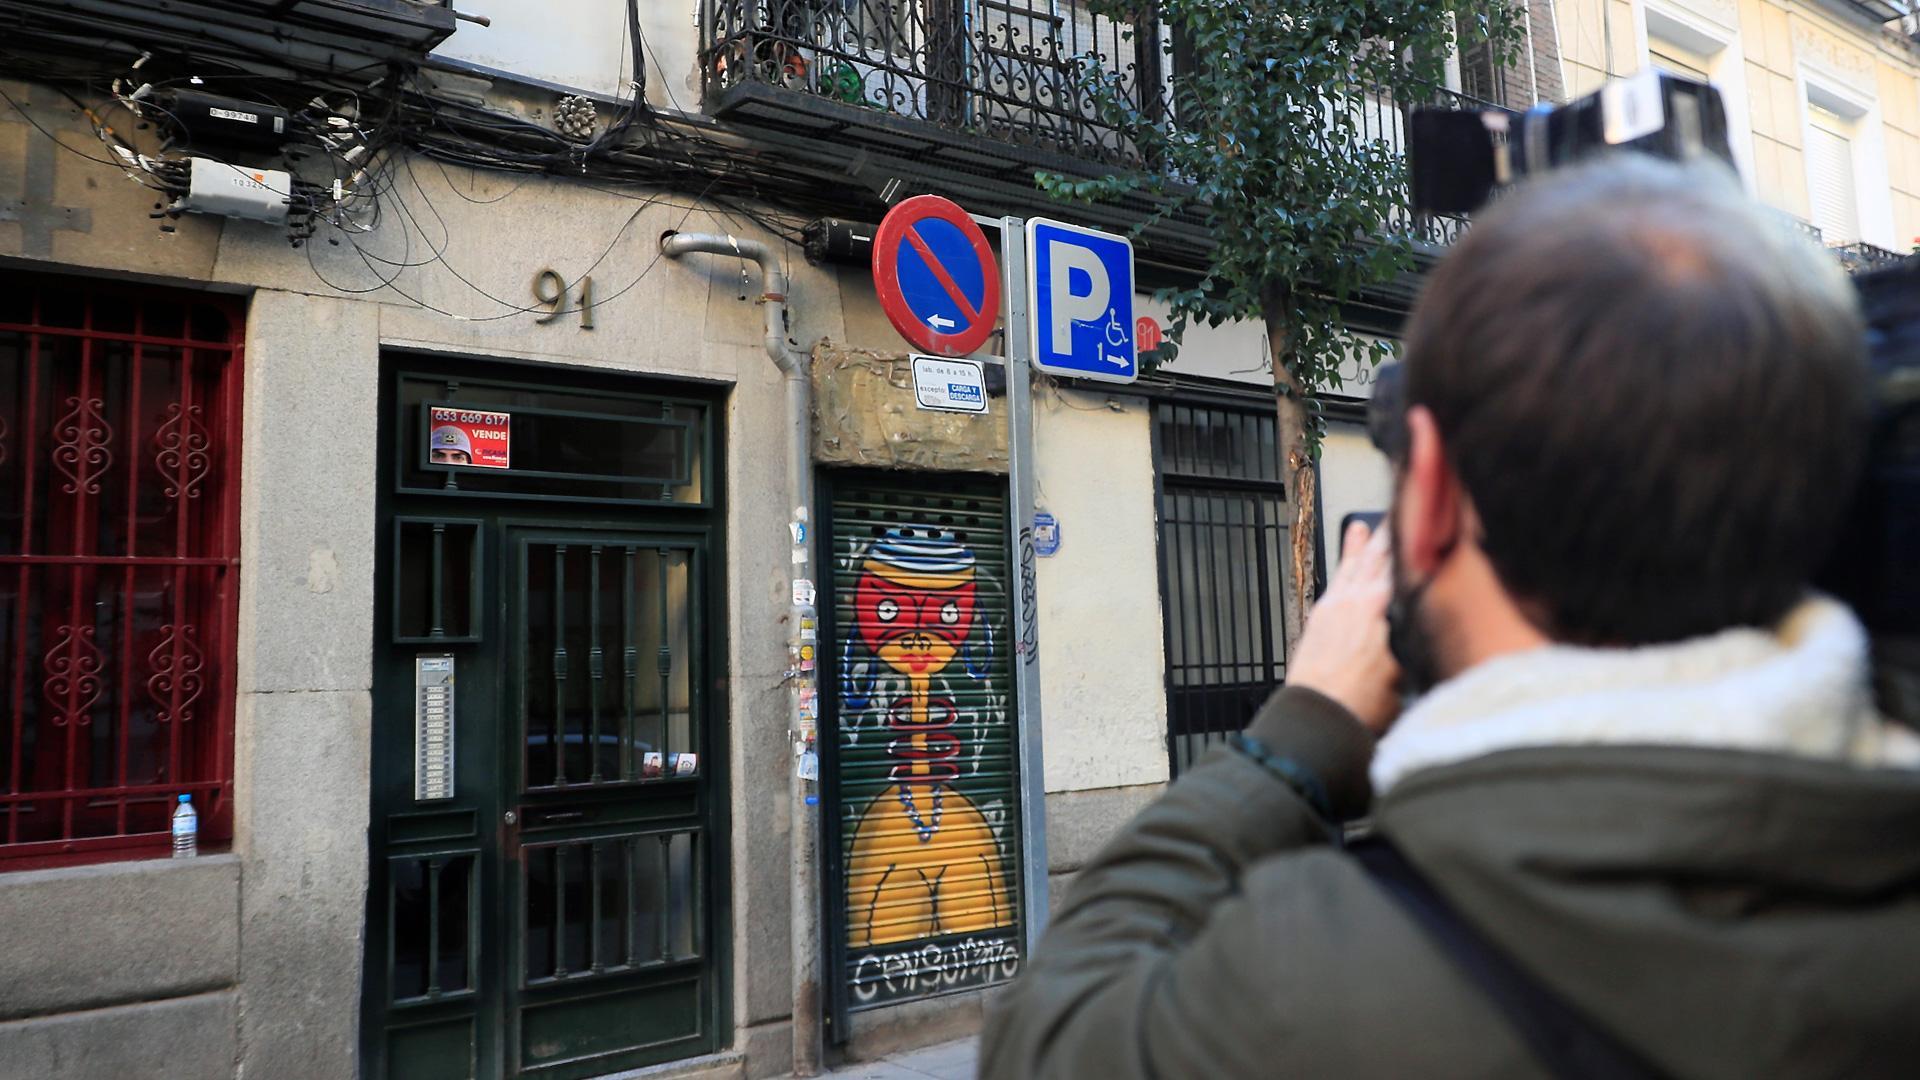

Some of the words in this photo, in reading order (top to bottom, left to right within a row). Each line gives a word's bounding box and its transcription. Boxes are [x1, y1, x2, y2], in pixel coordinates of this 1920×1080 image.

[531, 267, 594, 330] 91
[1050, 240, 1110, 356] P
[1097, 342, 1103, 361] 1
[435, 410, 457, 422] 653
[460, 412, 482, 423] 669
[485, 414, 506, 425] 617
[472, 429, 507, 441] VENDE
